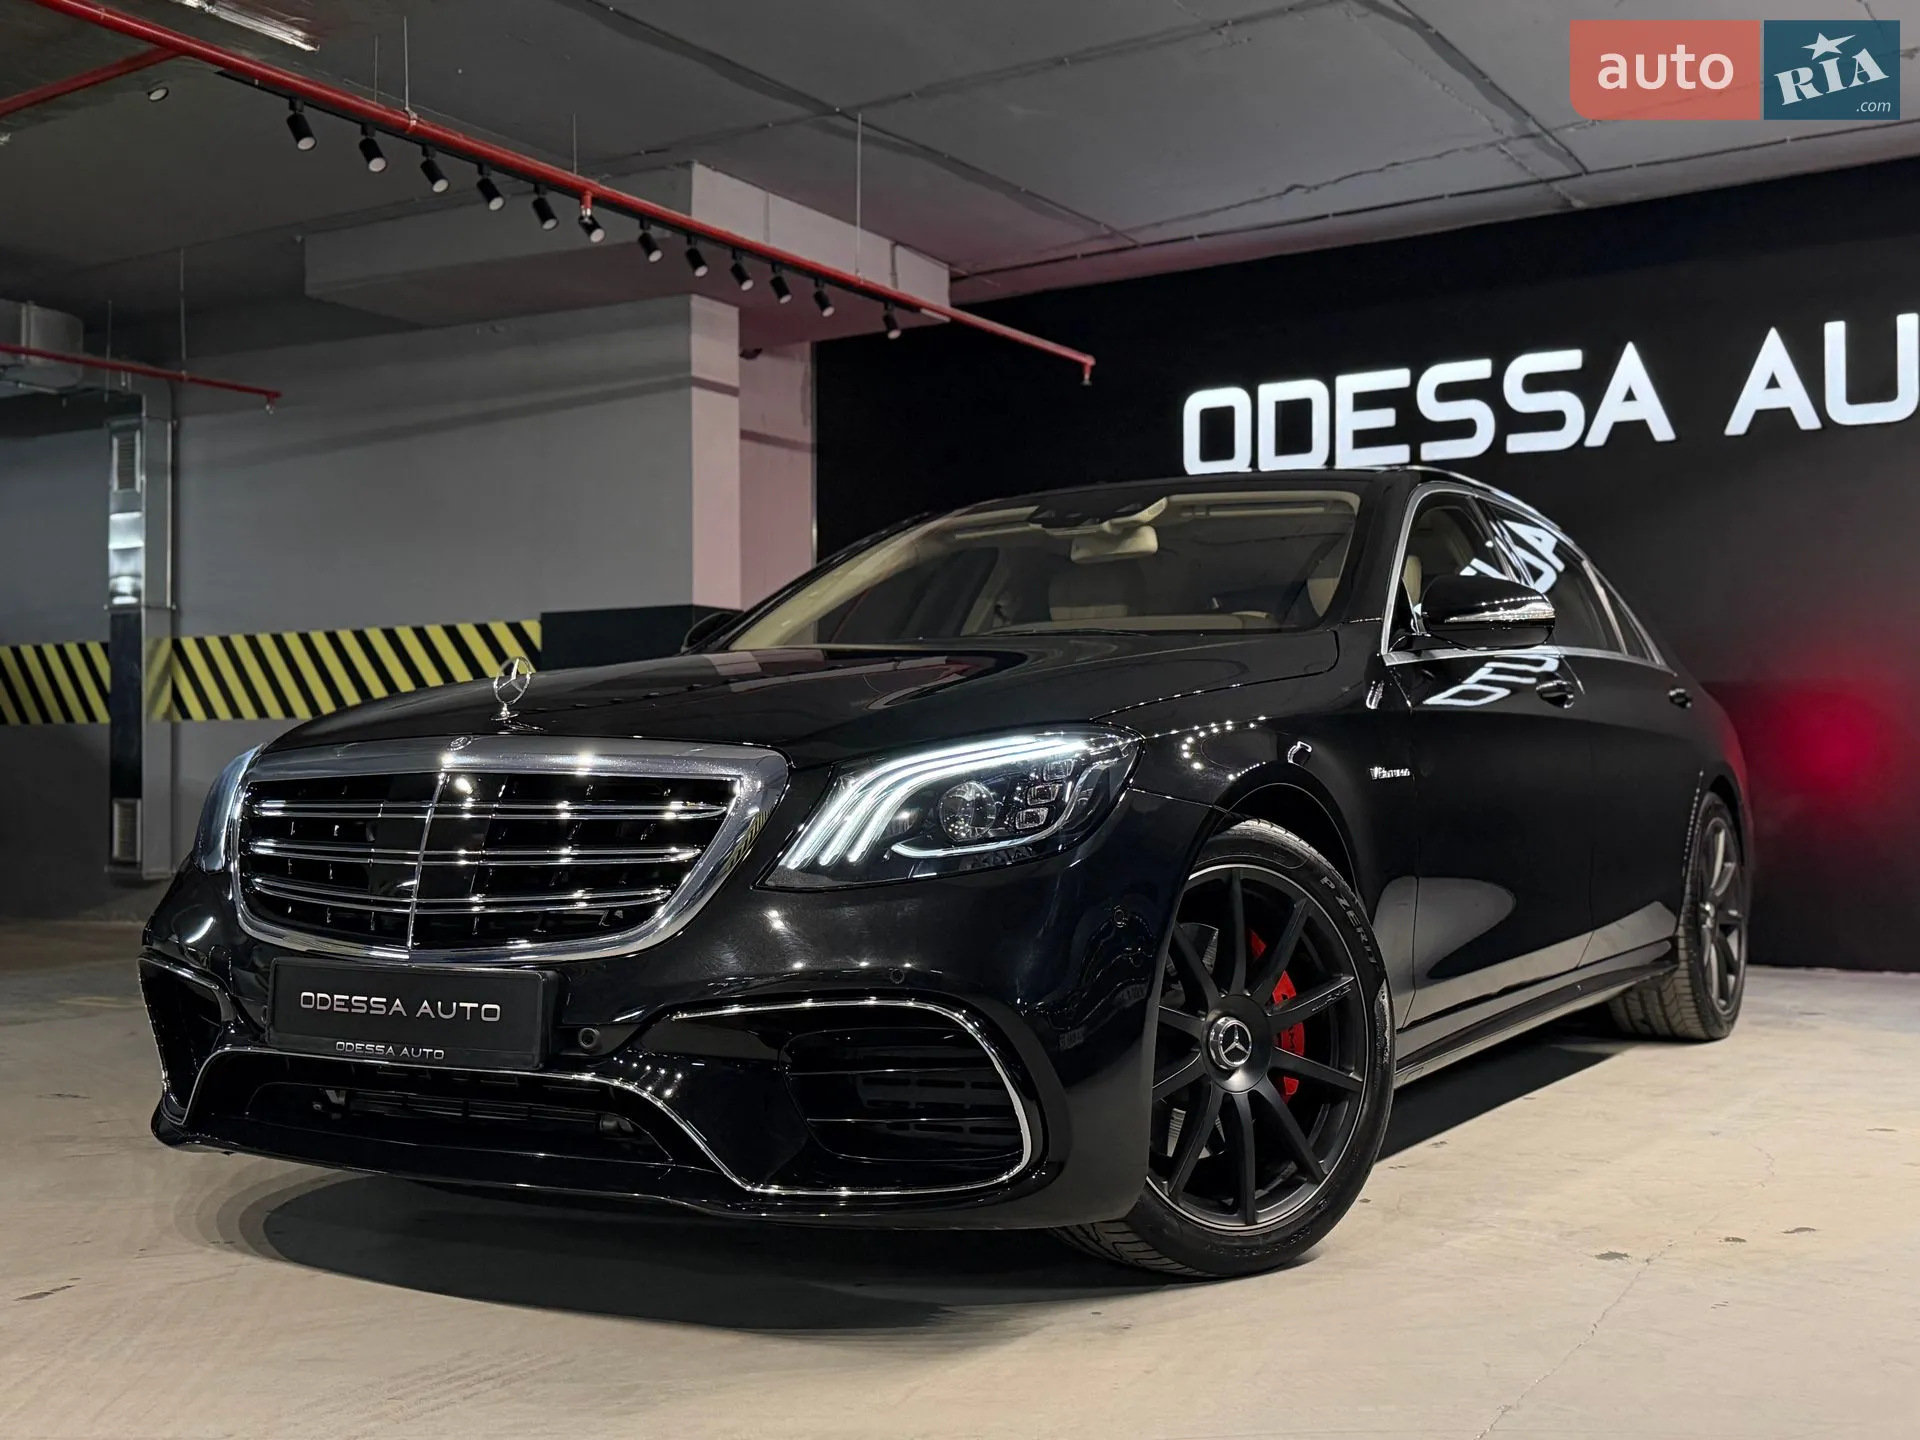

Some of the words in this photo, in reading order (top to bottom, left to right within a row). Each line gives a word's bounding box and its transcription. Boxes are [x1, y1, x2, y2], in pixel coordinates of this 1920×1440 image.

[1183, 341, 1676, 475] ODESSA
[1724, 312, 1920, 436] AU
[300, 991, 407, 1017] ODESSA
[415, 999, 501, 1022] AUTO
[335, 1041, 395, 1057] ODESSA
[399, 1046, 445, 1060] AUTO
